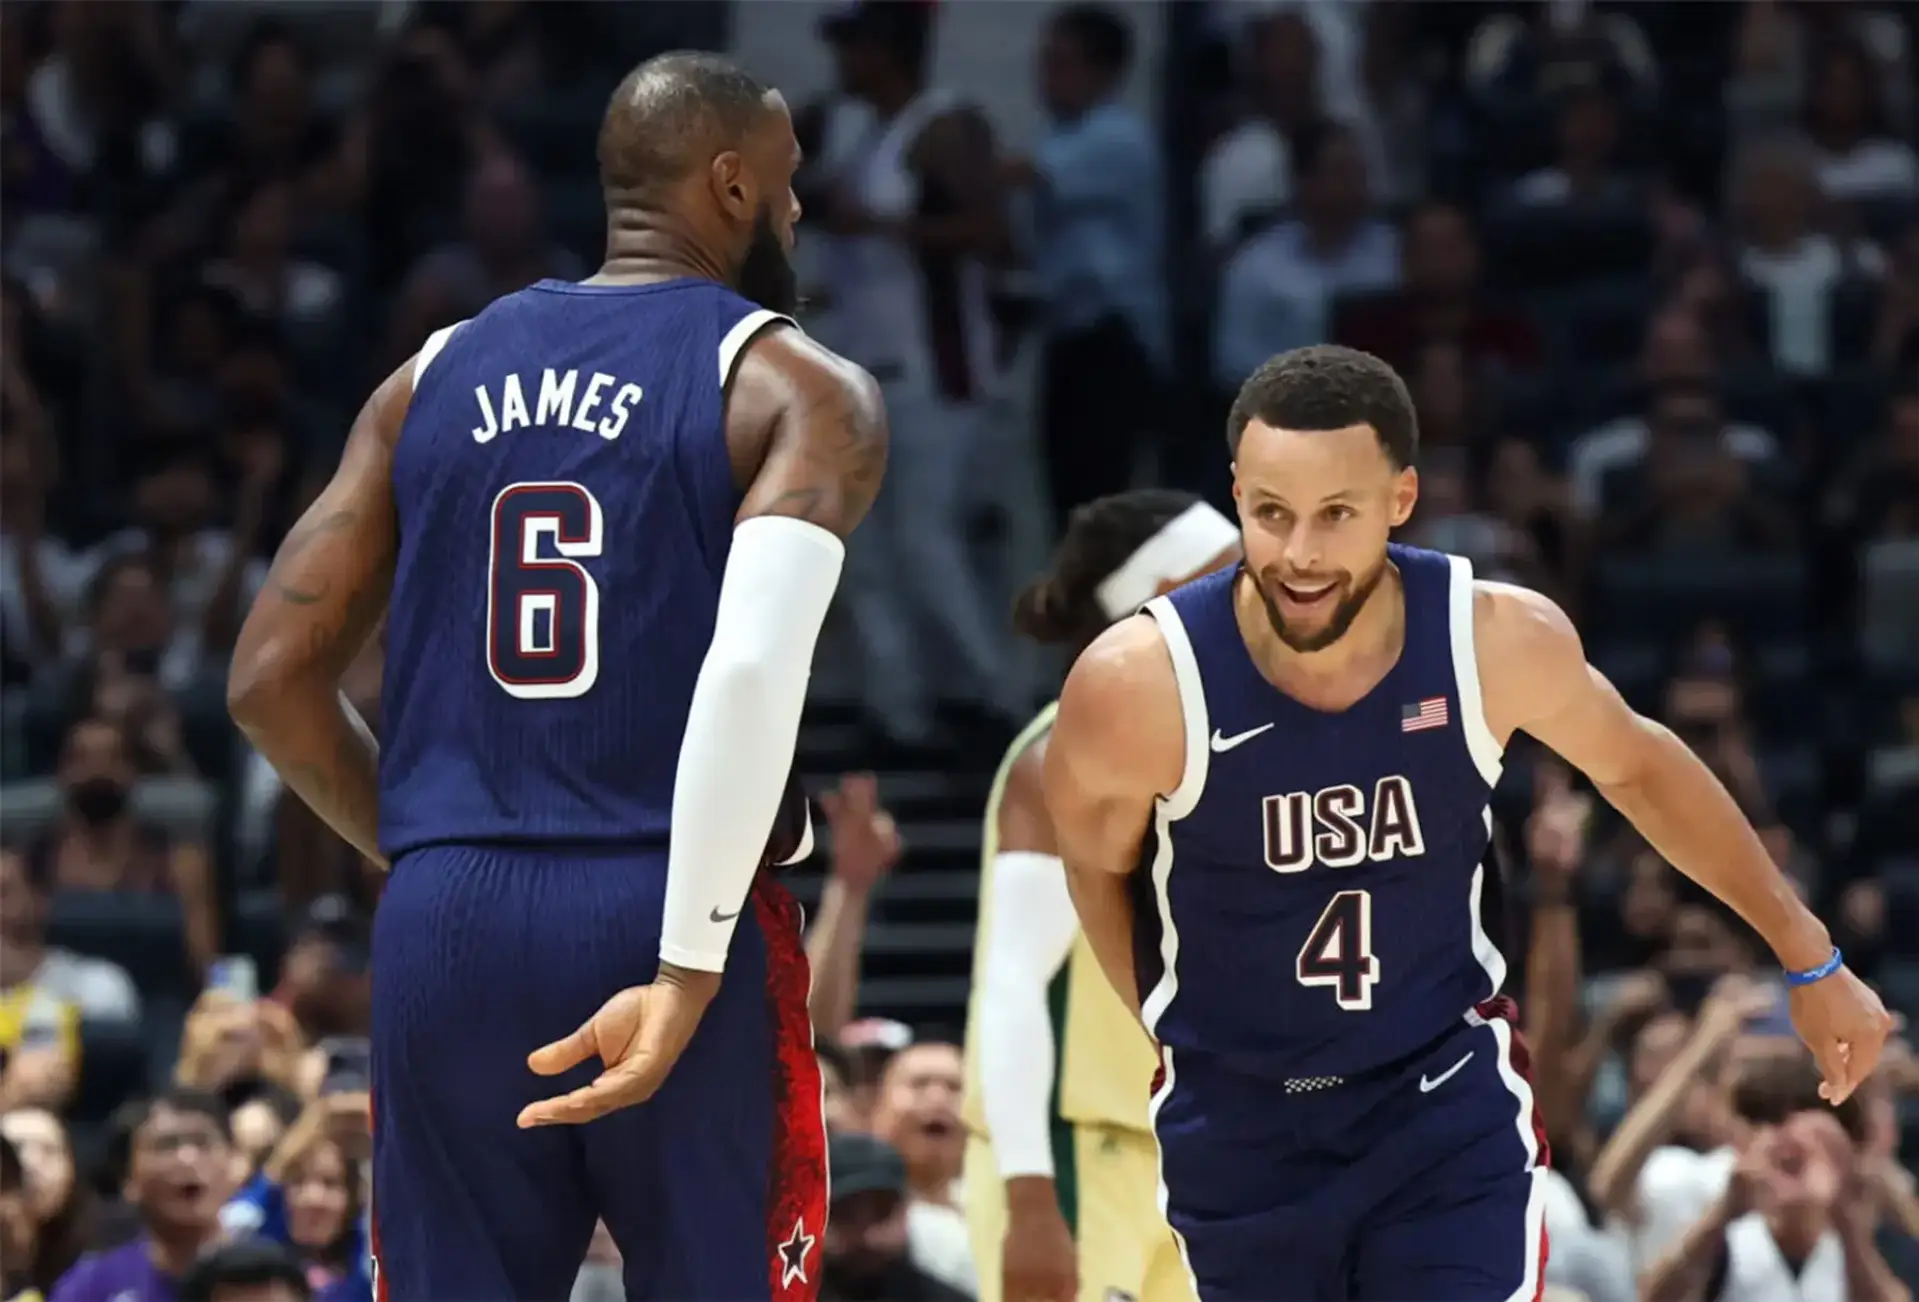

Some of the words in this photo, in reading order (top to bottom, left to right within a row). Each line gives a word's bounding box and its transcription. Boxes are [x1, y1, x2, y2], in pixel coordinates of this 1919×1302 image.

[471, 367, 643, 444] JAMES
[486, 481, 604, 699] 6
[1262, 775, 1425, 873] USA
[1296, 889, 1380, 1011] 4
